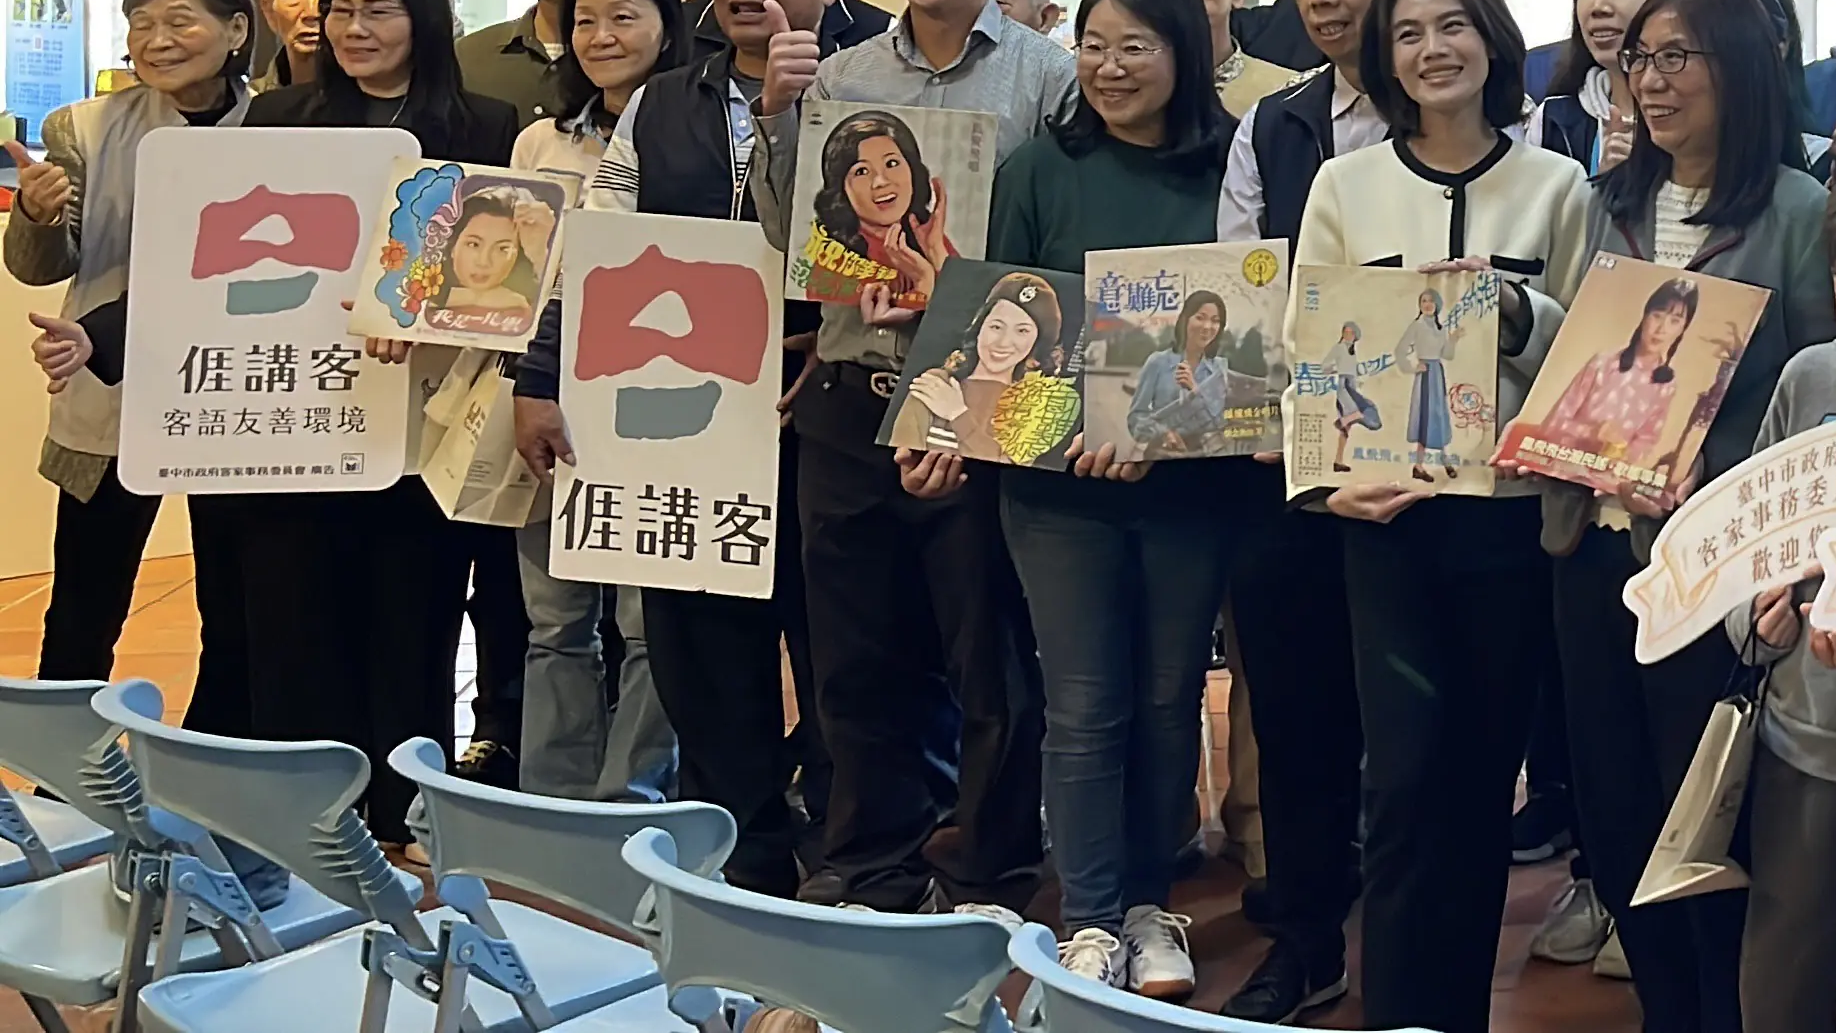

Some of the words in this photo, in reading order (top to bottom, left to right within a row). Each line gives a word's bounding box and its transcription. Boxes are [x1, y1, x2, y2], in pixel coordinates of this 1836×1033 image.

[161, 405, 369, 437] 客語友善環境
